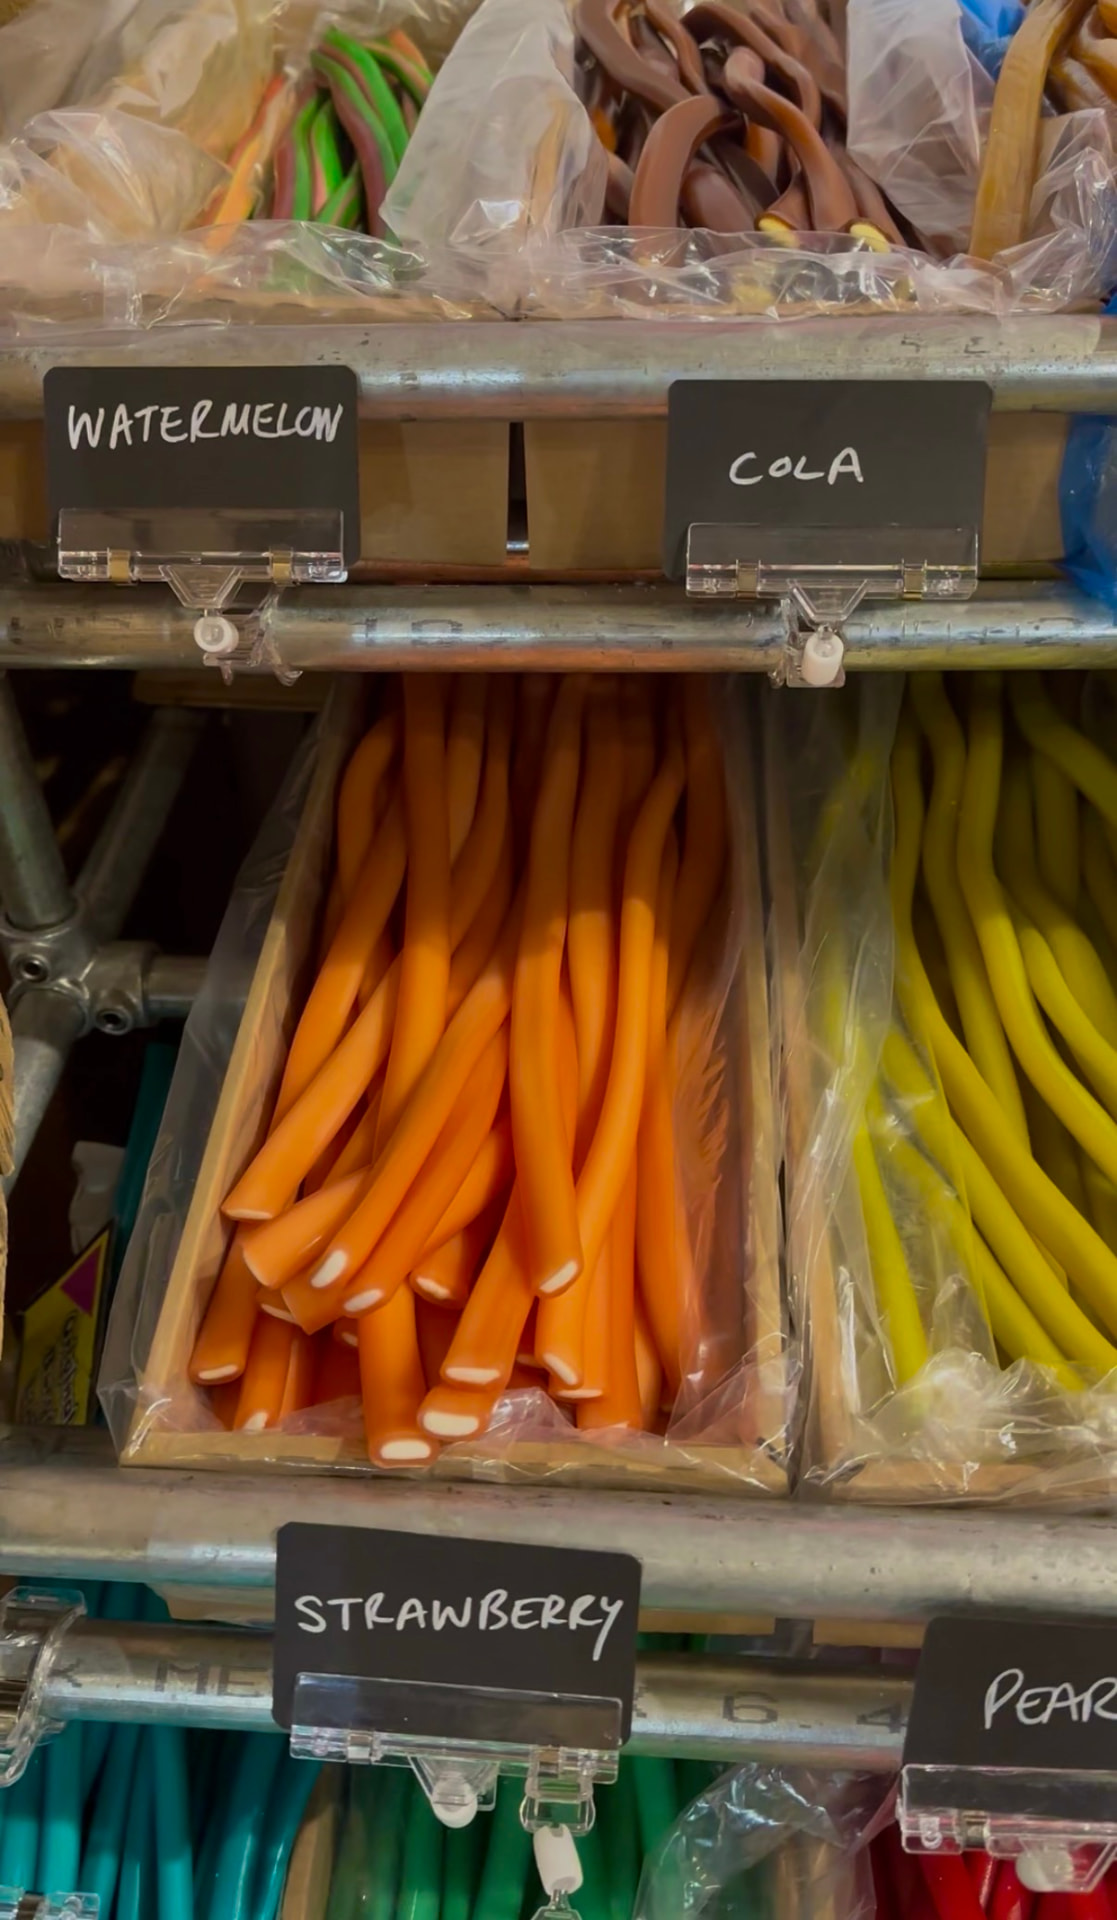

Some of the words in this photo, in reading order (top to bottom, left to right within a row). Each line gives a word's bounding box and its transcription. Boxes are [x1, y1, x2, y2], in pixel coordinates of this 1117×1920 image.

[729, 447, 864, 485] COLA
[294, 1588, 624, 1661] STRAWBERRY
[984, 1667, 1117, 1729] PEAR
